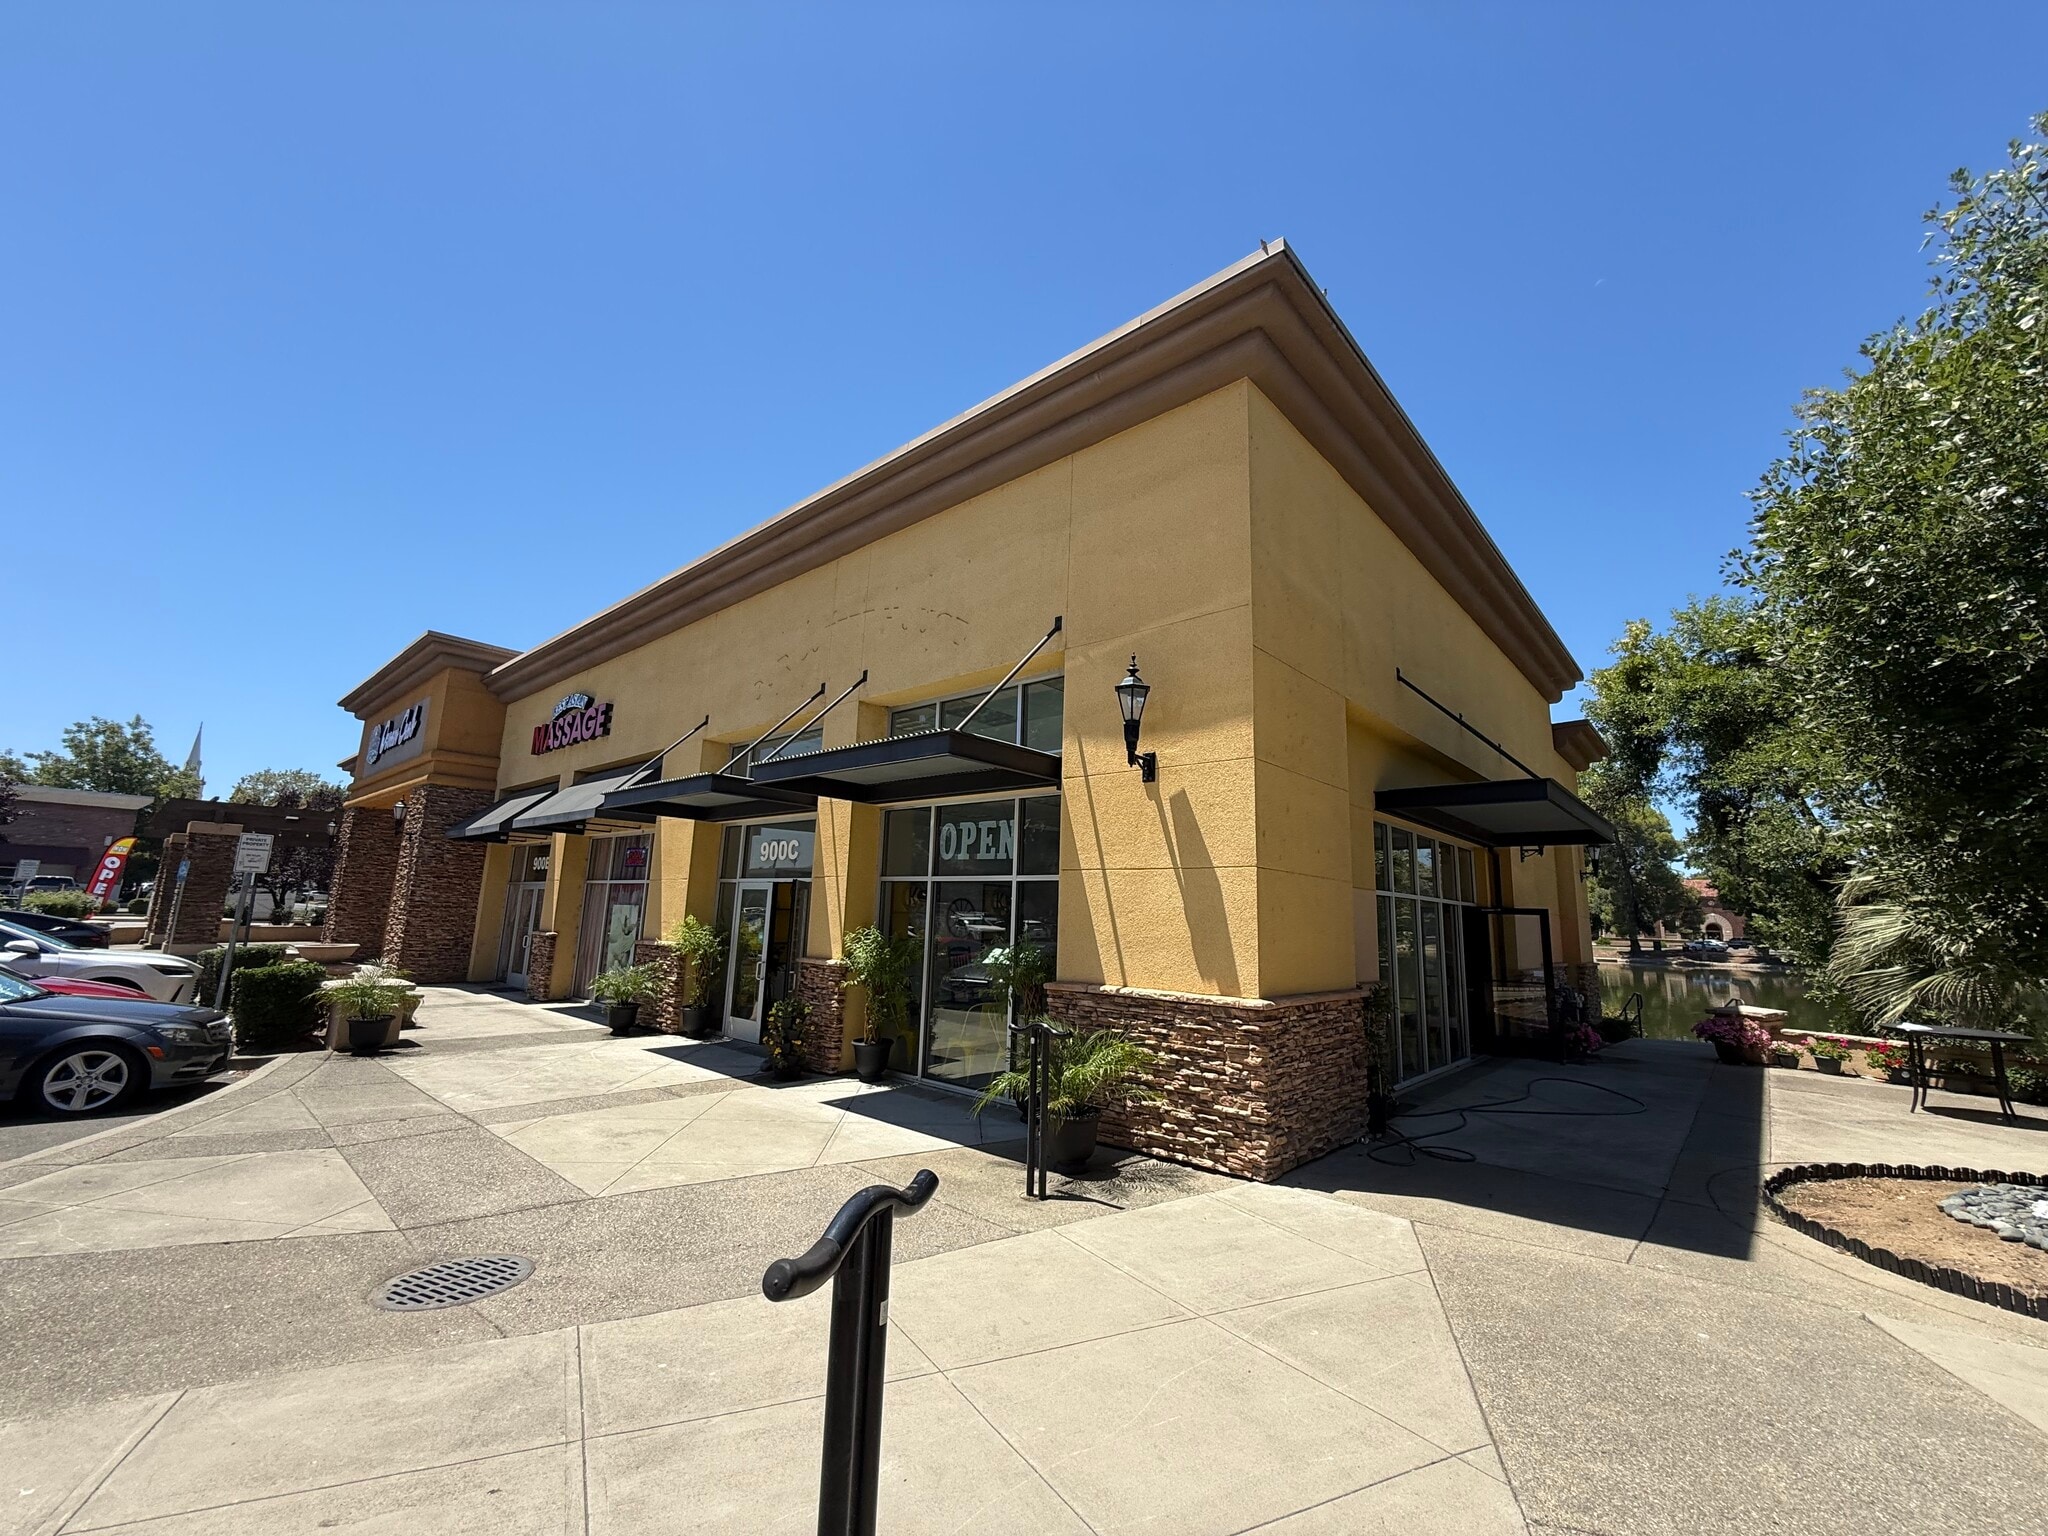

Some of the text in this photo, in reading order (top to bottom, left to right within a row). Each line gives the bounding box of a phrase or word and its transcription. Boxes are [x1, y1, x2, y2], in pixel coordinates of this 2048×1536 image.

[532, 702, 609, 755] MASSAGE
[760, 839, 799, 861] 900C
[940, 819, 1014, 860] OPEN
